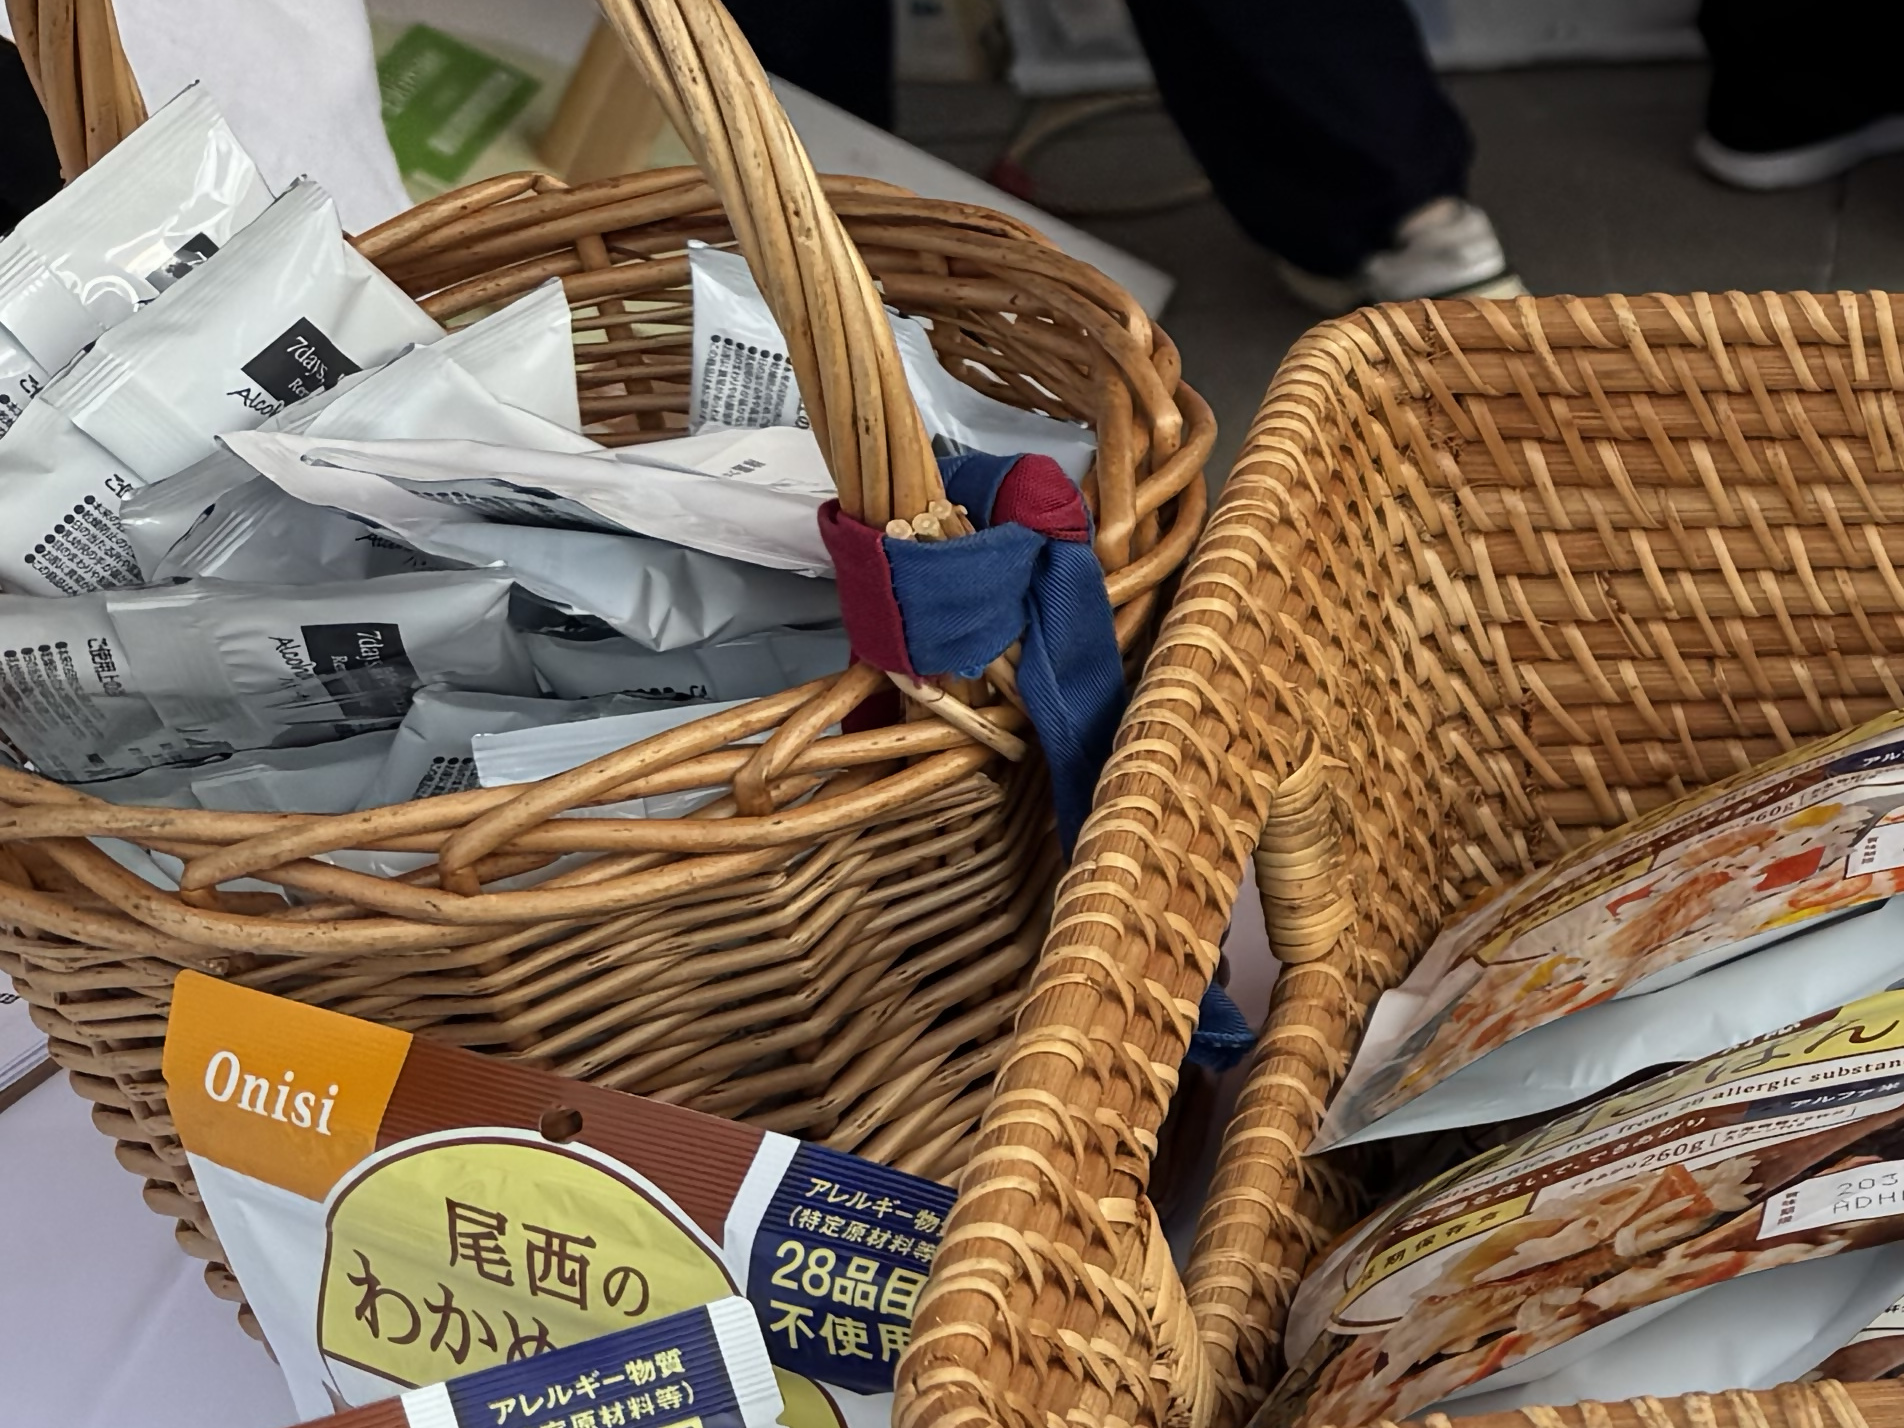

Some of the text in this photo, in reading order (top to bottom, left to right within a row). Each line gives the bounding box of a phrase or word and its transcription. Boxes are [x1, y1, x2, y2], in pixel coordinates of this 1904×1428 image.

[204, 1050, 339, 1135] Onisi
[1711, 1073, 1802, 1101] allergic
[1790, 1079, 1901, 1110] アルファ米
[1641, 1136, 1706, 1169] 260g
[445, 1197, 650, 1317] 尾西の
[771, 1240, 930, 1320] 28品目
[769, 1299, 913, 1363] 不使用
[488, 1348, 687, 1425] アレルギー物質
